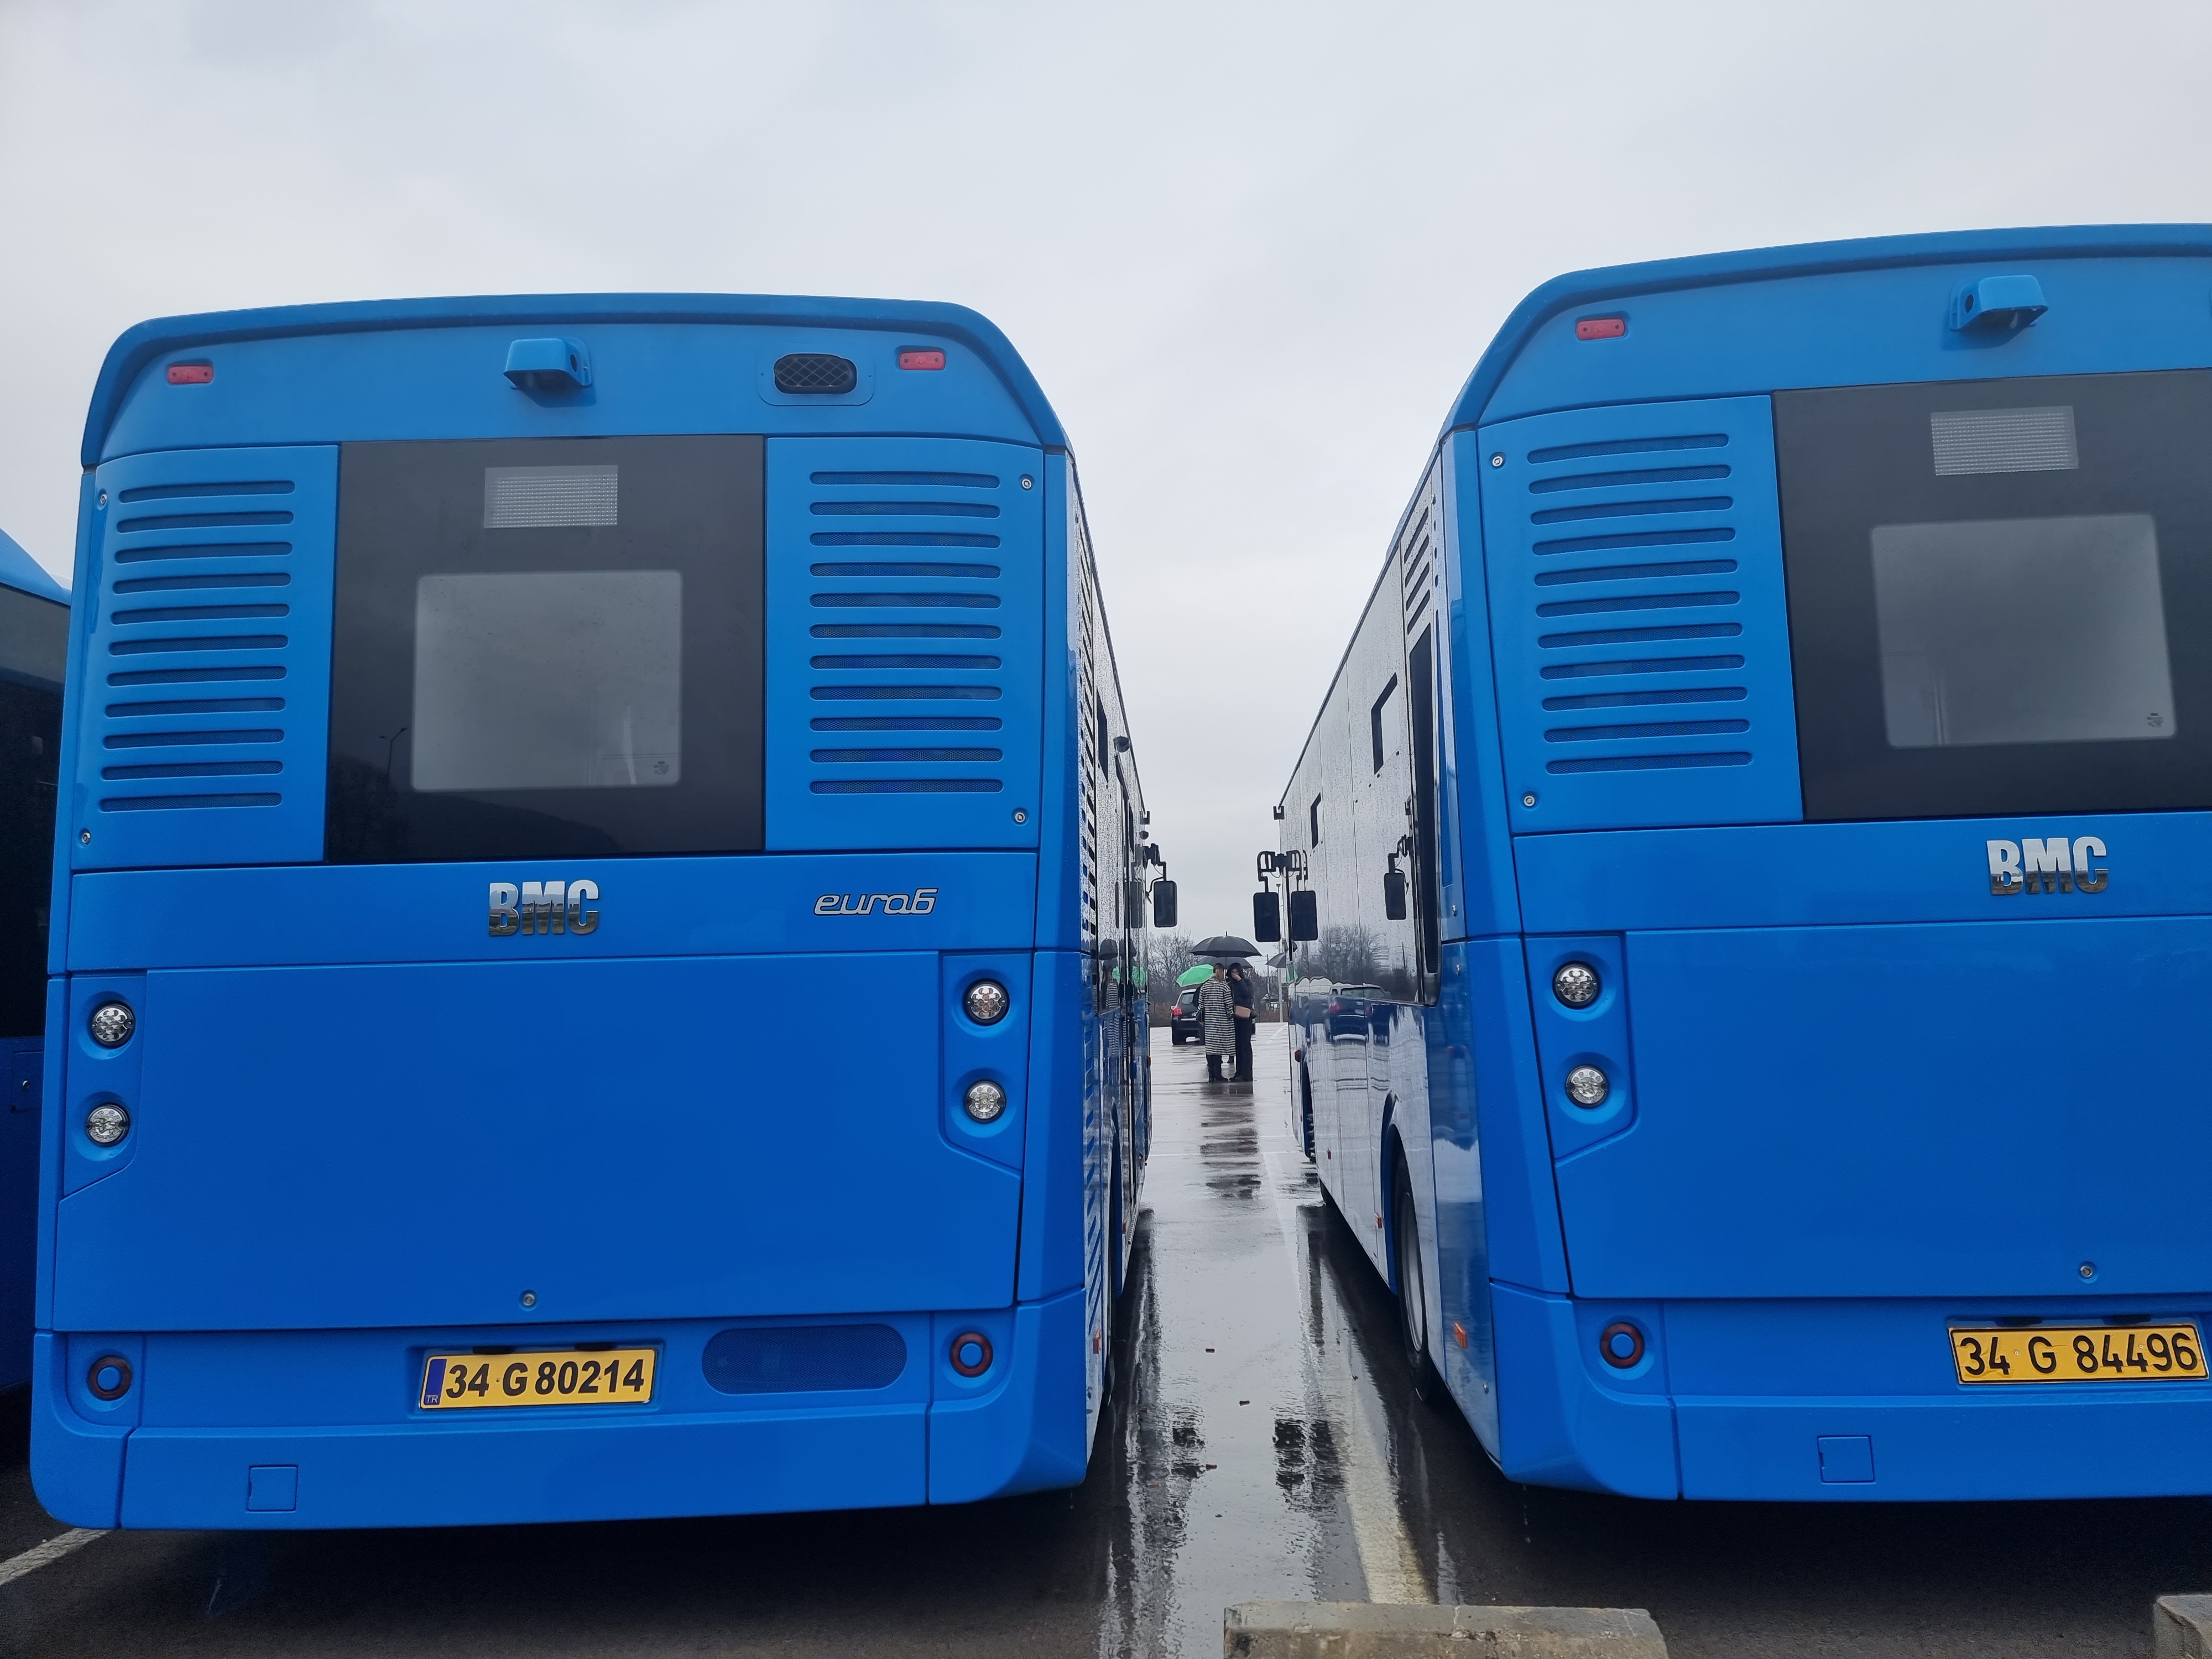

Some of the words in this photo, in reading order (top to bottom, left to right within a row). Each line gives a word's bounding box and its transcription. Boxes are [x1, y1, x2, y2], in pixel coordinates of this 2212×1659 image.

[1986, 836, 2108, 895] BMC
[489, 879, 599, 936] BMC
[813, 888, 939, 916] euro6
[1960, 1336, 2011, 1375] 34
[2028, 1336, 2057, 1374] G
[2072, 1332, 2198, 1374] 84496
[445, 1363, 491, 1398] 34
[502, 1363, 528, 1396] G
[534, 1359, 645, 1395] 80214
[427, 1395, 439, 1404] TR
